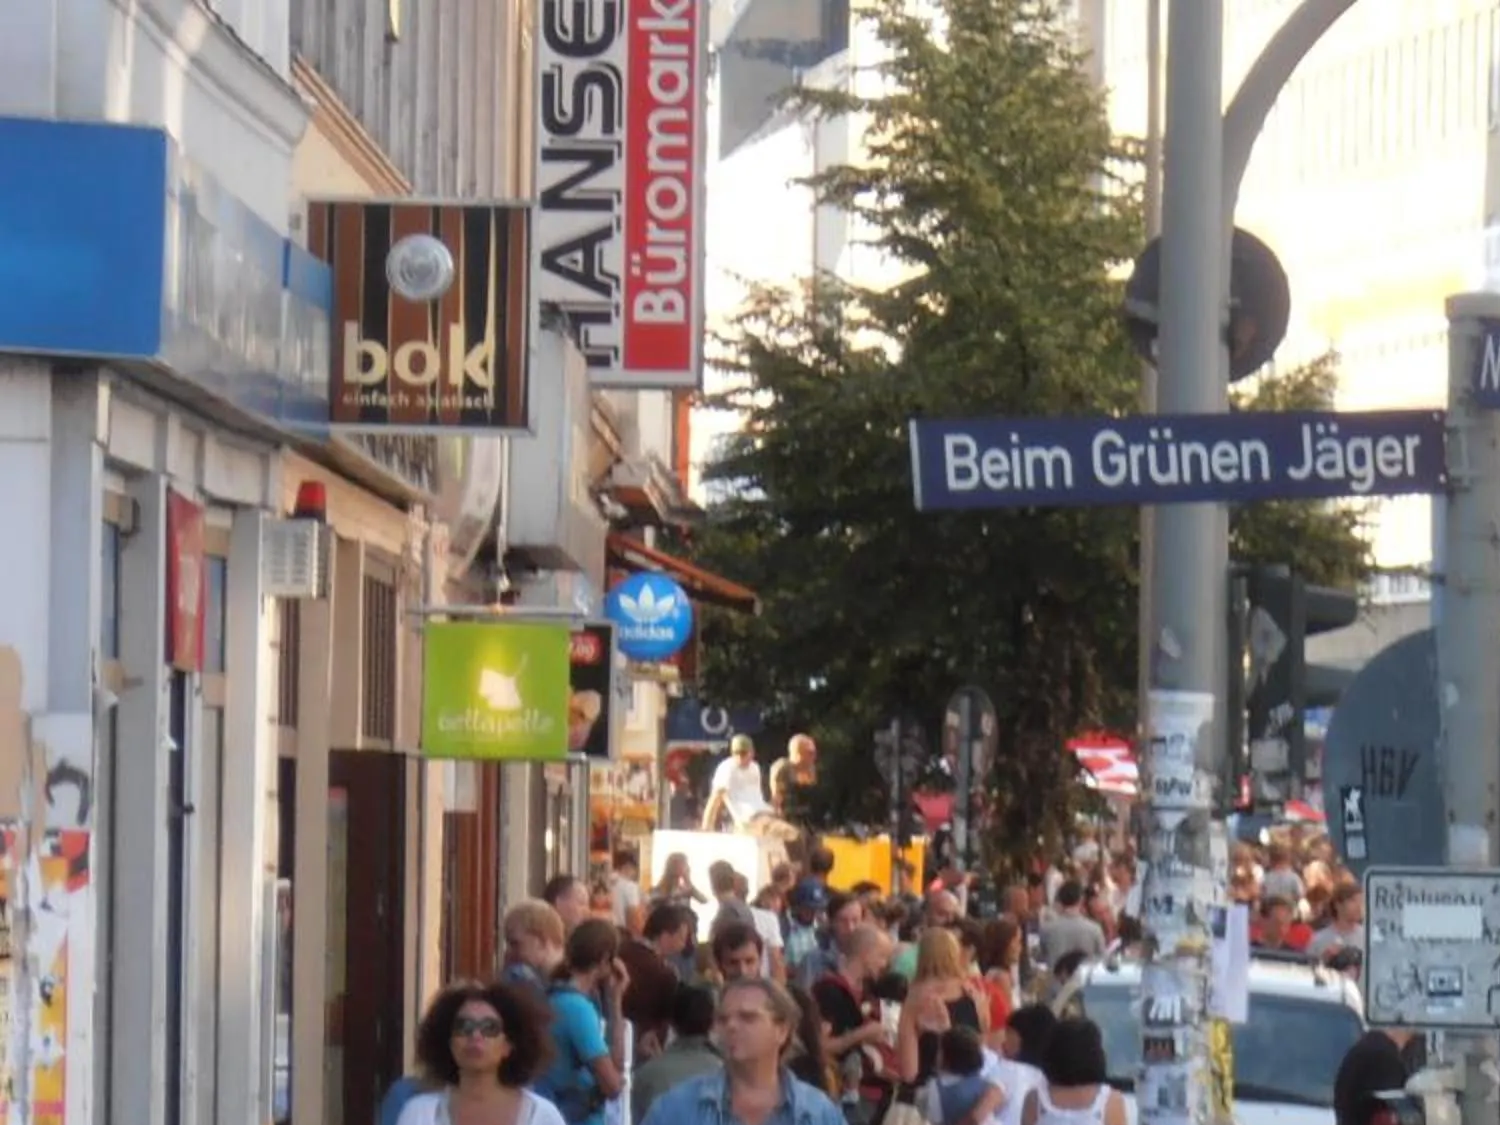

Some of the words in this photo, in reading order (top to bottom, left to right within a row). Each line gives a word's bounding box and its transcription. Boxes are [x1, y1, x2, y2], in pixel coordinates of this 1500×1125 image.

[343, 320, 496, 388] bok
[943, 433, 1074, 492] Beim
[1091, 428, 1272, 487] Grünen
[1287, 423, 1422, 494] Jäger
